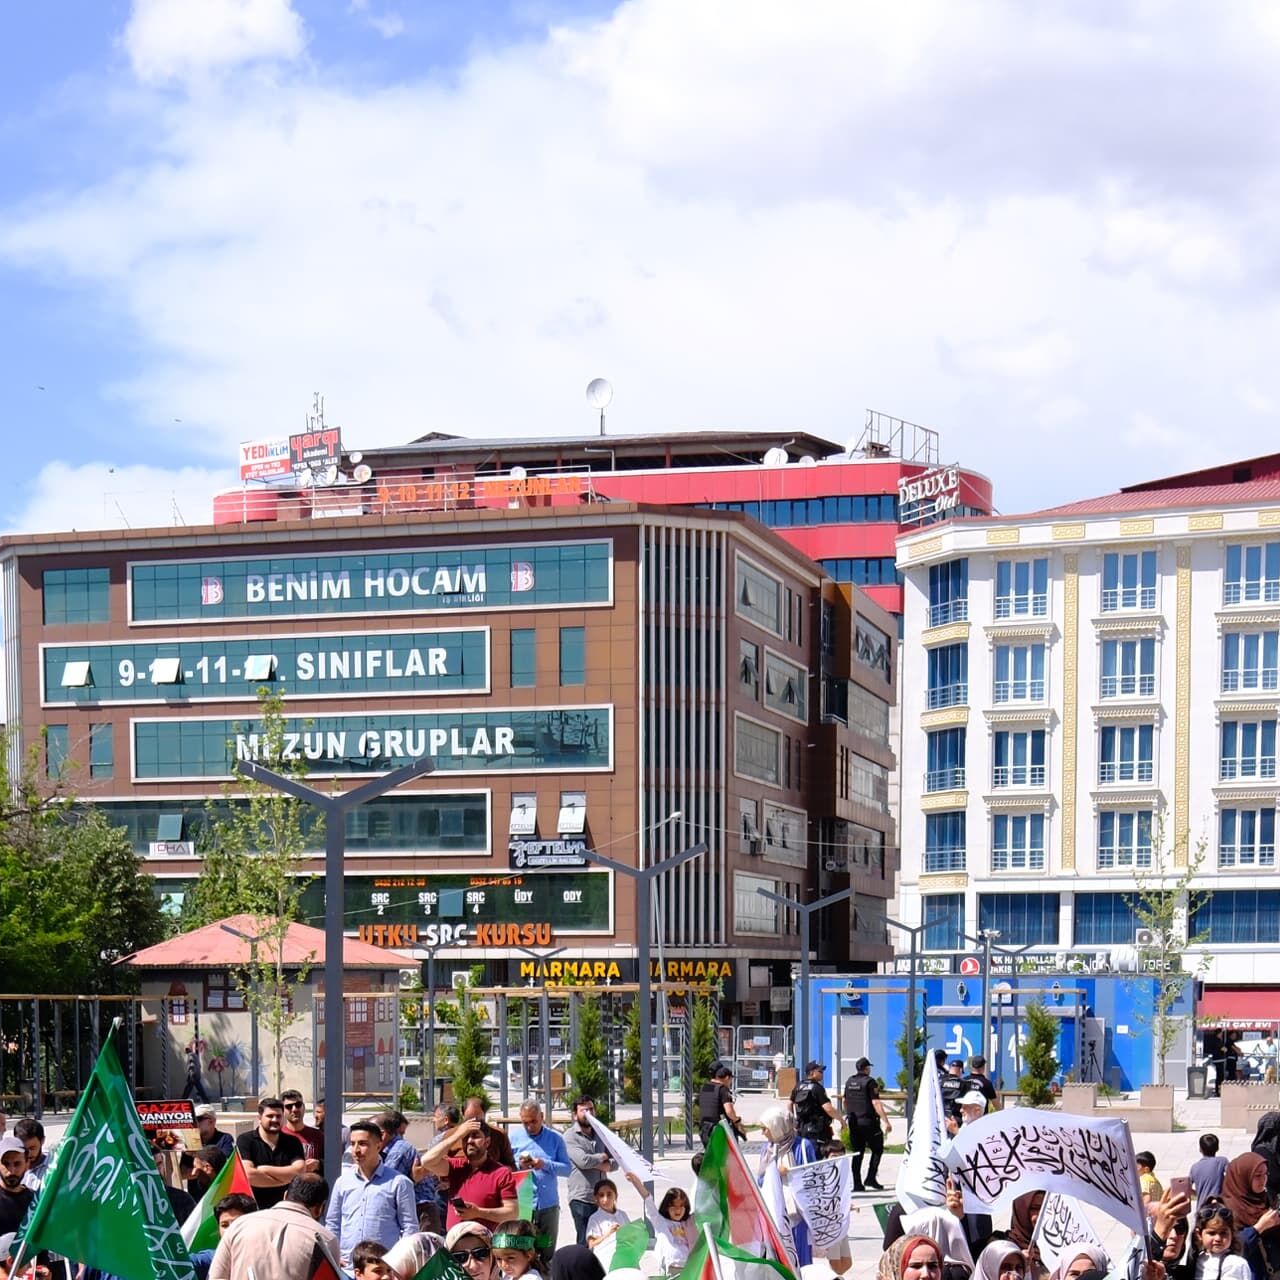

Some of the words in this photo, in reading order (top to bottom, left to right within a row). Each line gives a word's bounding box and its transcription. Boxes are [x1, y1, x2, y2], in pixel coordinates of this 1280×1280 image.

[899, 471, 957, 506] DELUXE
[365, 564, 486, 597] HOCAM
[296, 648, 448, 681] SINIFLAR
[365, 727, 515, 758] GRUPLAR
[371, 893, 390, 903] SRC
[419, 893, 437, 903] SRC
[467, 892, 486, 902] SRC
[377, 905, 385, 915] 2
[425, 905, 431, 915] 3
[472, 904, 480, 914] 4
[359, 923, 418, 946] UTKU
[427, 924, 468, 946] SRC
[477, 923, 552, 946] KURSU
[520, 961, 620, 977] MARMARA
[137, 1103, 191, 1113] GAZZE
[140, 1112, 192, 1121] YANIYOR
